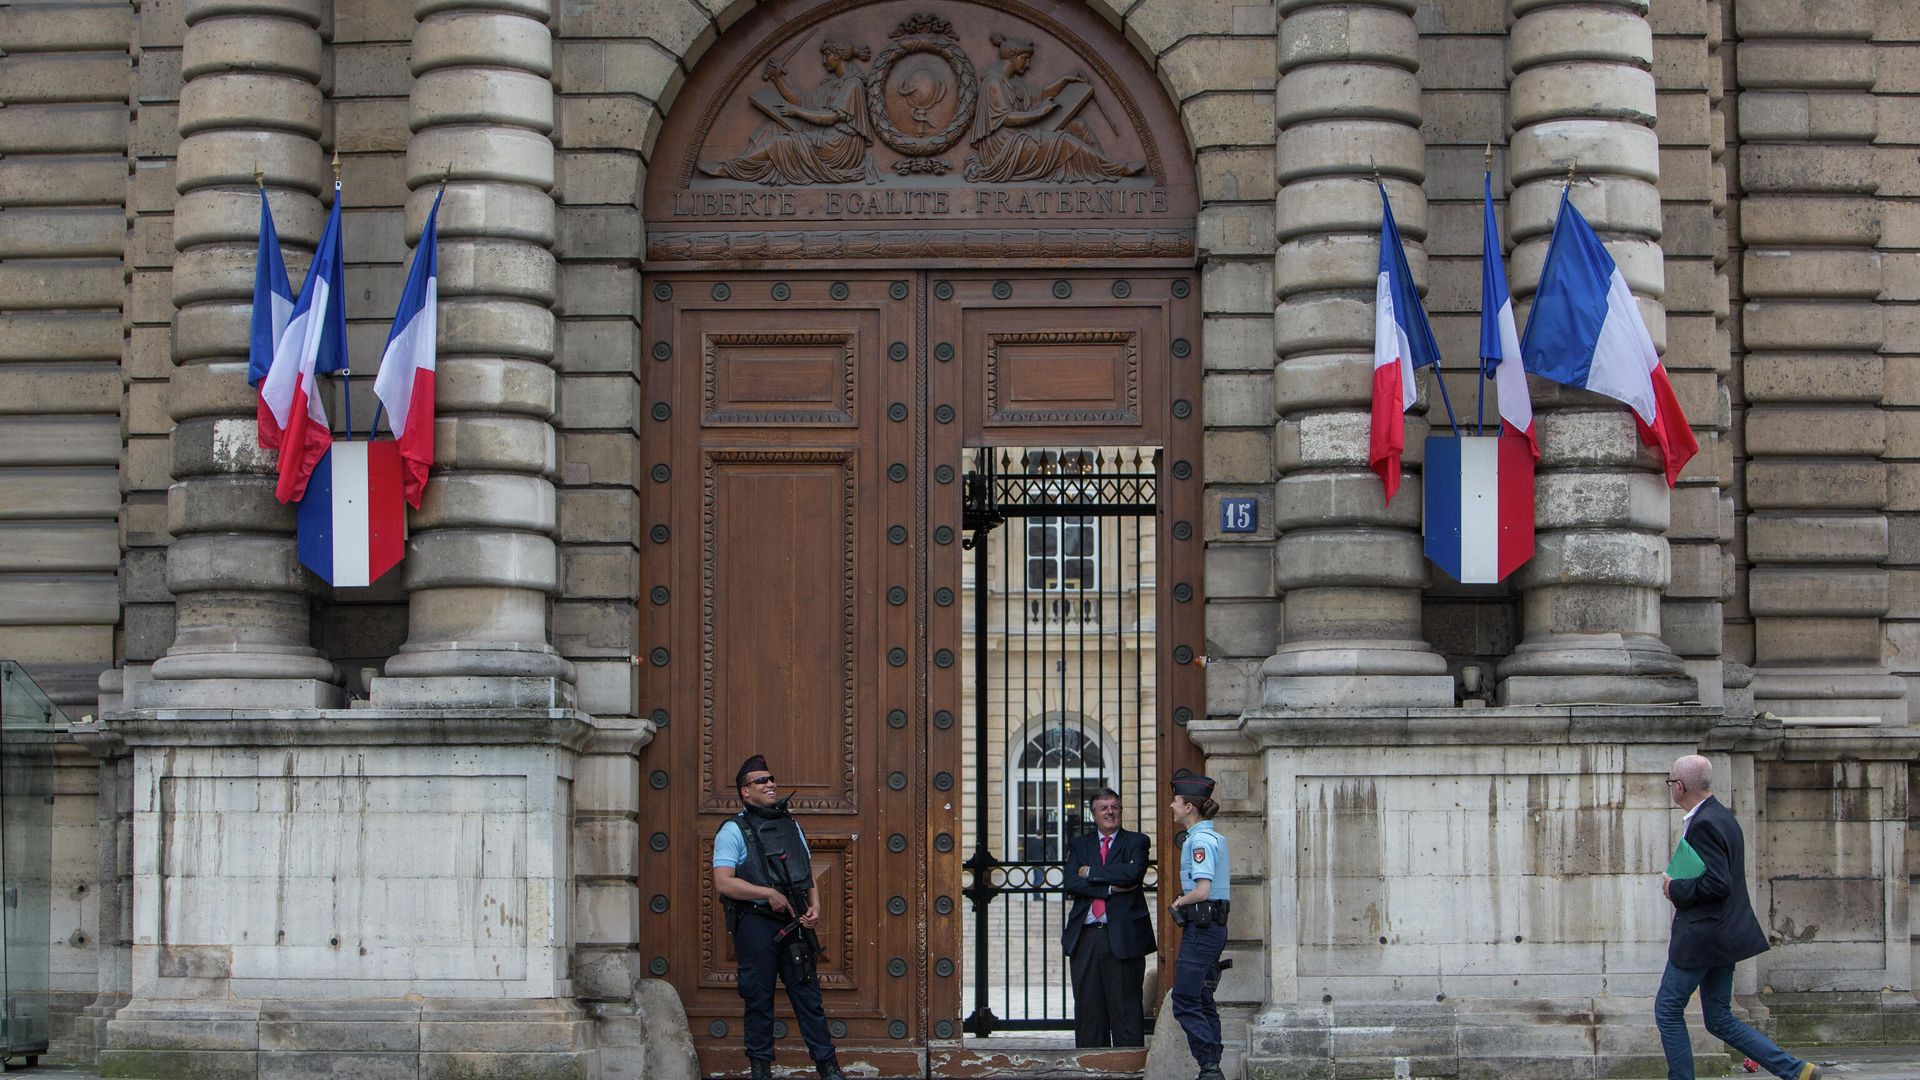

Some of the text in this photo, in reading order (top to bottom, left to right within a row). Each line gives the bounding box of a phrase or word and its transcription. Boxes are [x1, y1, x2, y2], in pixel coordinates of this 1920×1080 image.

[673, 190, 1168, 216] LIBERTE EGALITE FRATERNITE
[1226, 503, 1251, 529] 15
